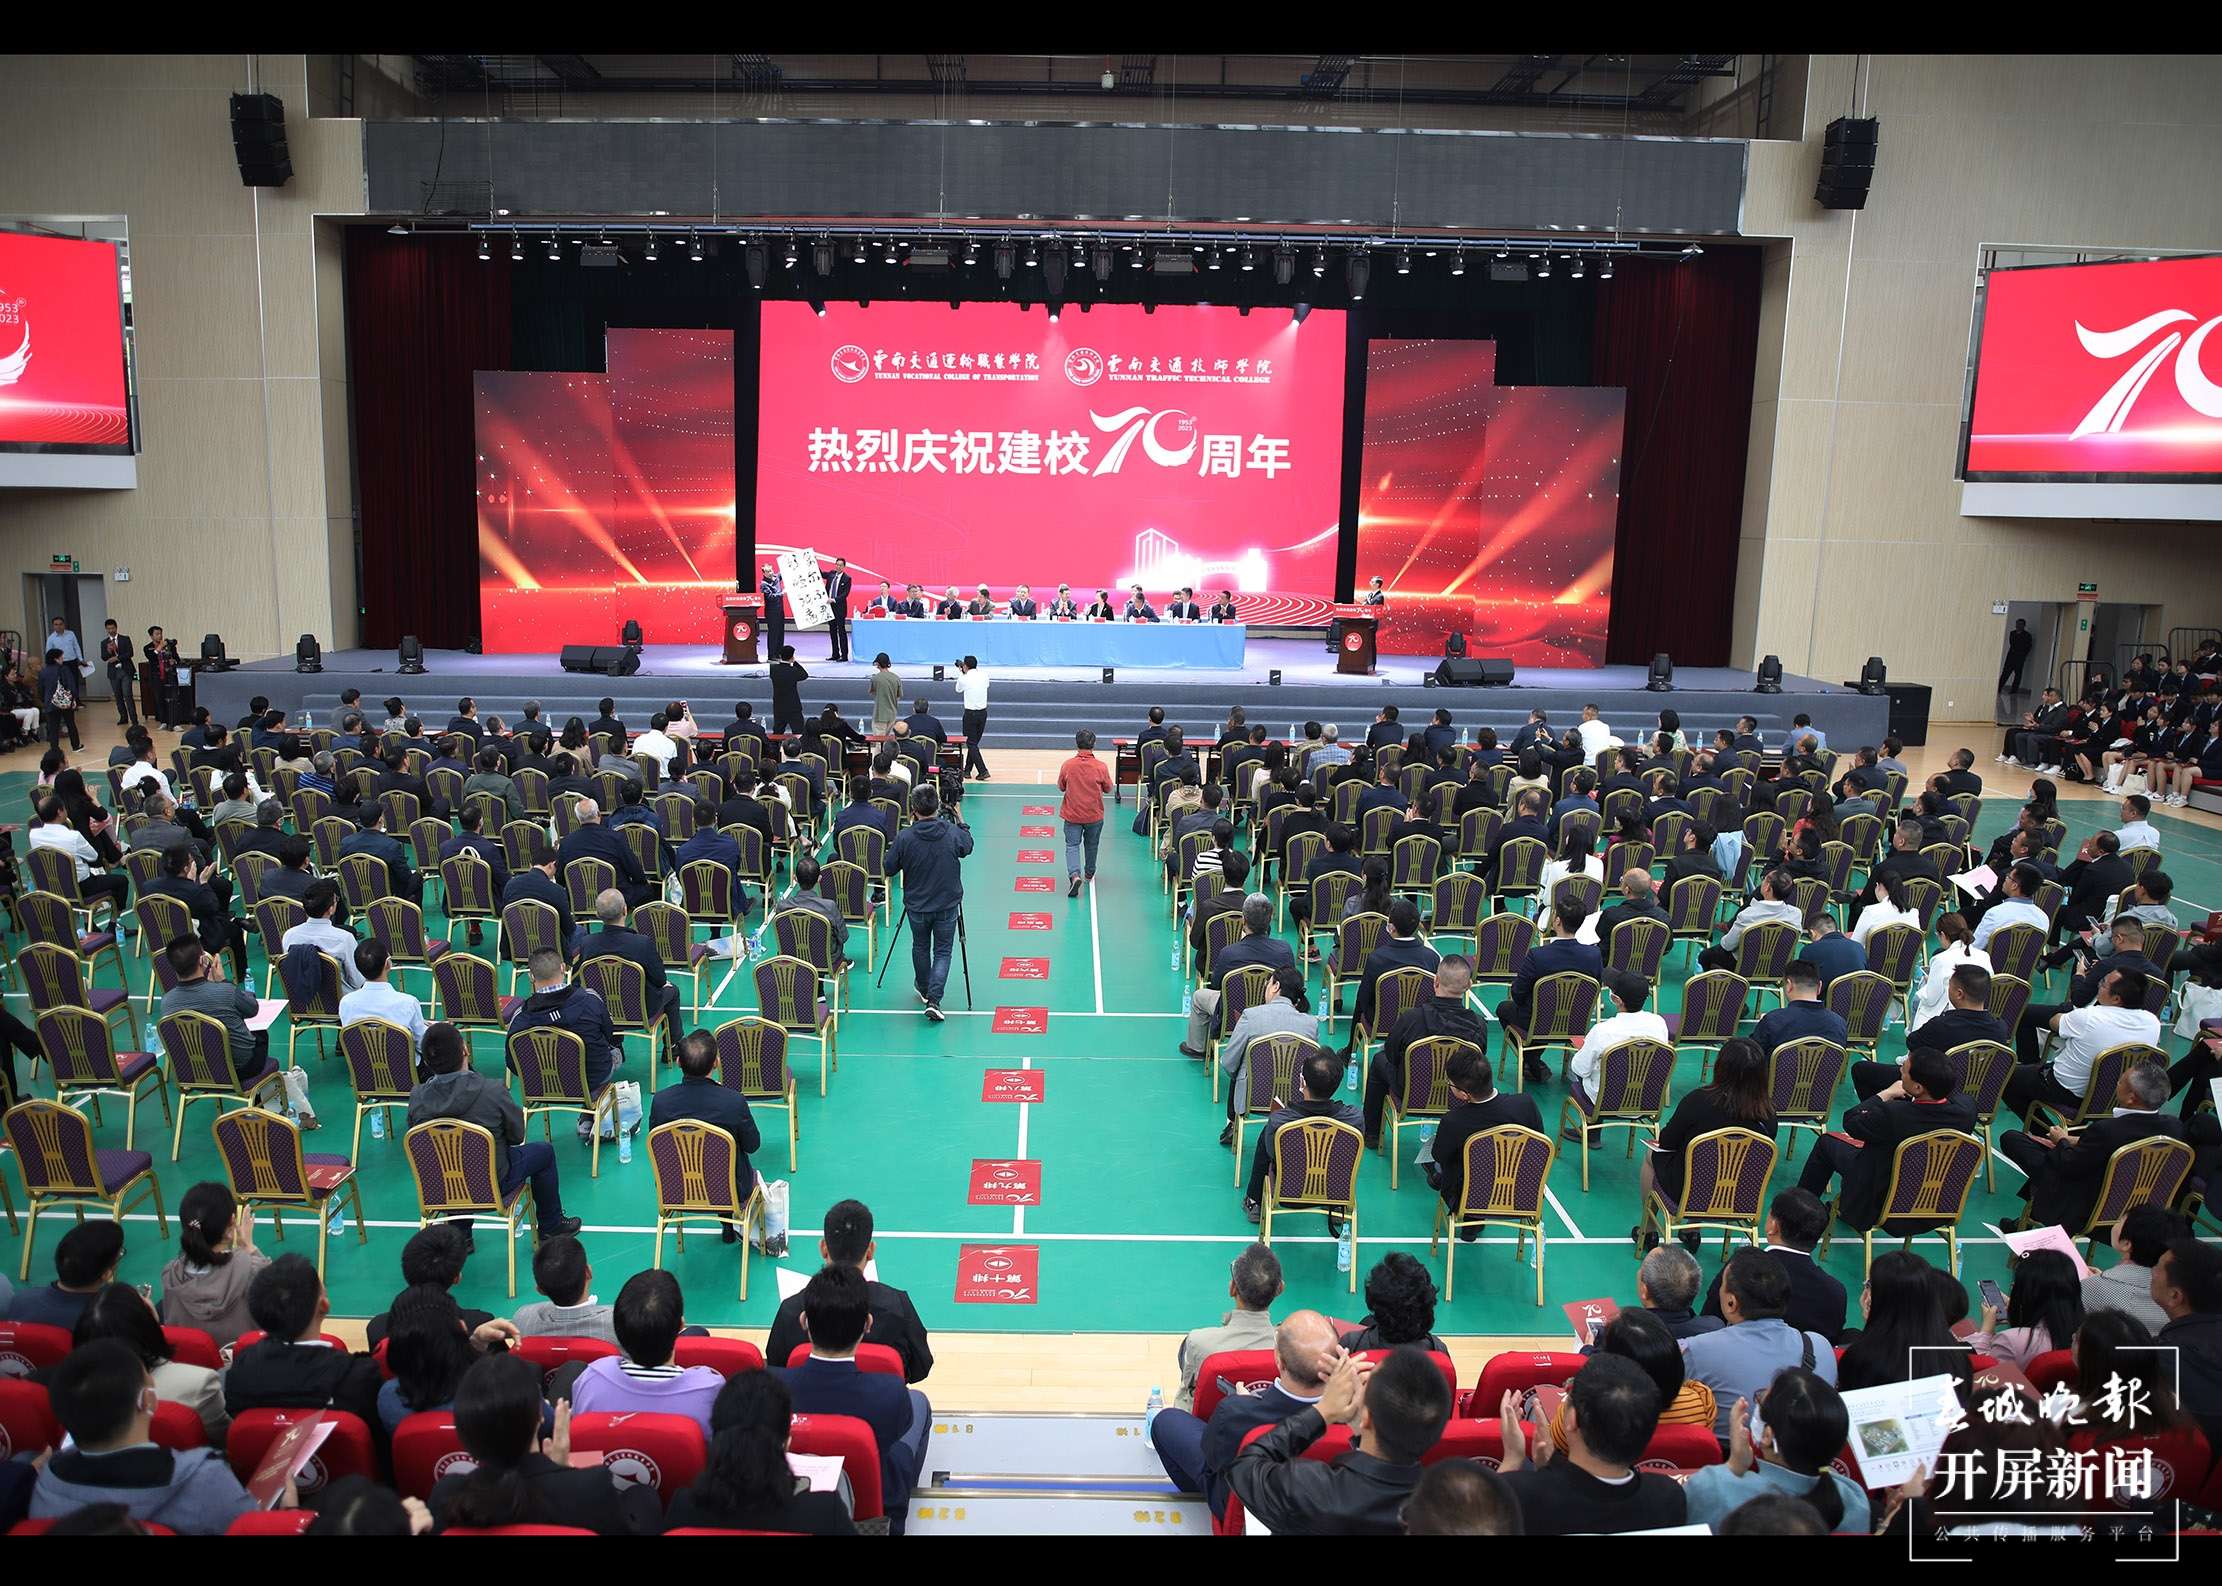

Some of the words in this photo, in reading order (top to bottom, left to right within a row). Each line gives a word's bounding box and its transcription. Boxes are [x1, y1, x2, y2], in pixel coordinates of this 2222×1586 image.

[903, 373, 942, 381] VOCATIONAL
[943, 373, 971, 381] COLLEGE
[1108, 373, 1144, 382] YUNNAN
[1145, 374, 1182, 383] TRAFFIC
[1184, 375, 1232, 383] TECHNICAL
[1233, 376, 1271, 384] COLLEGE
[983, 1182, 1027, 1190] 第九排
[972, 1273, 1022, 1283] 第十排
